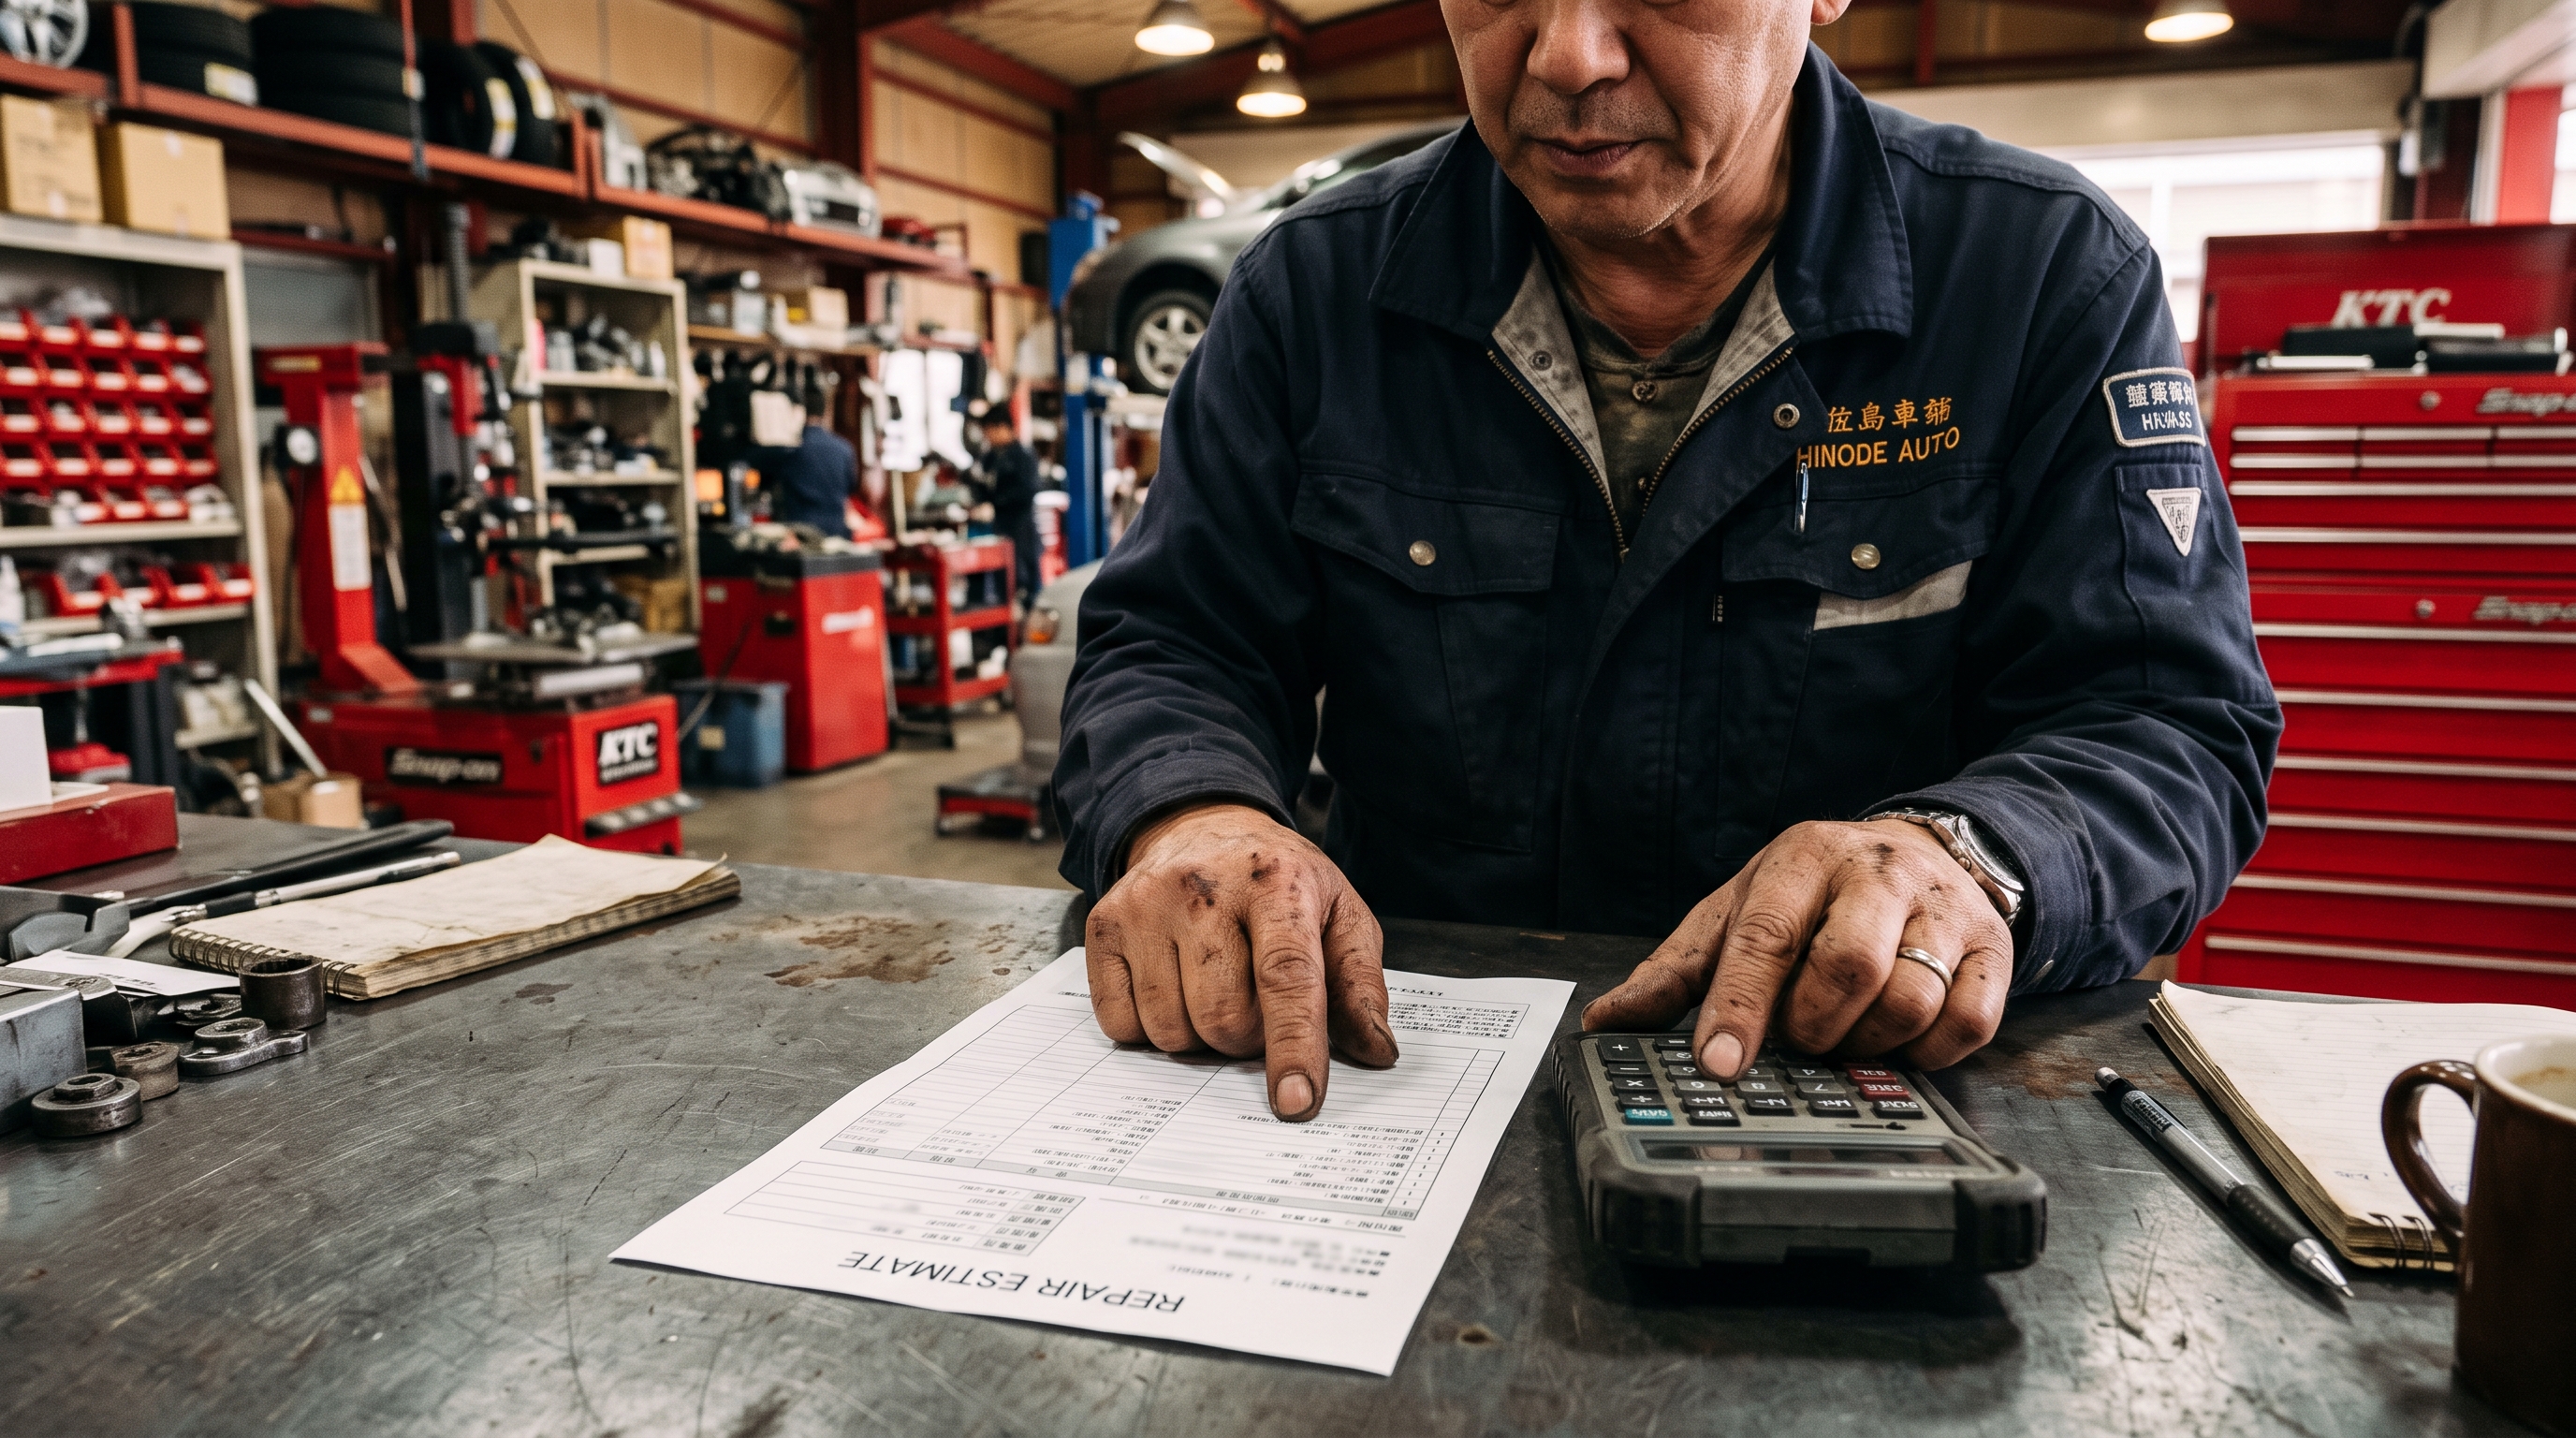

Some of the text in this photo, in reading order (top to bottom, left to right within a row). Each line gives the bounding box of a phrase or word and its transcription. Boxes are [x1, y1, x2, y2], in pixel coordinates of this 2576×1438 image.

[2332, 286, 2452, 329] KTC
[1796, 426, 1960, 469] HINODE AUTO
[597, 721, 659, 768] KTC
[838, 1251, 1185, 1313] REPAIR ESTIMATE
